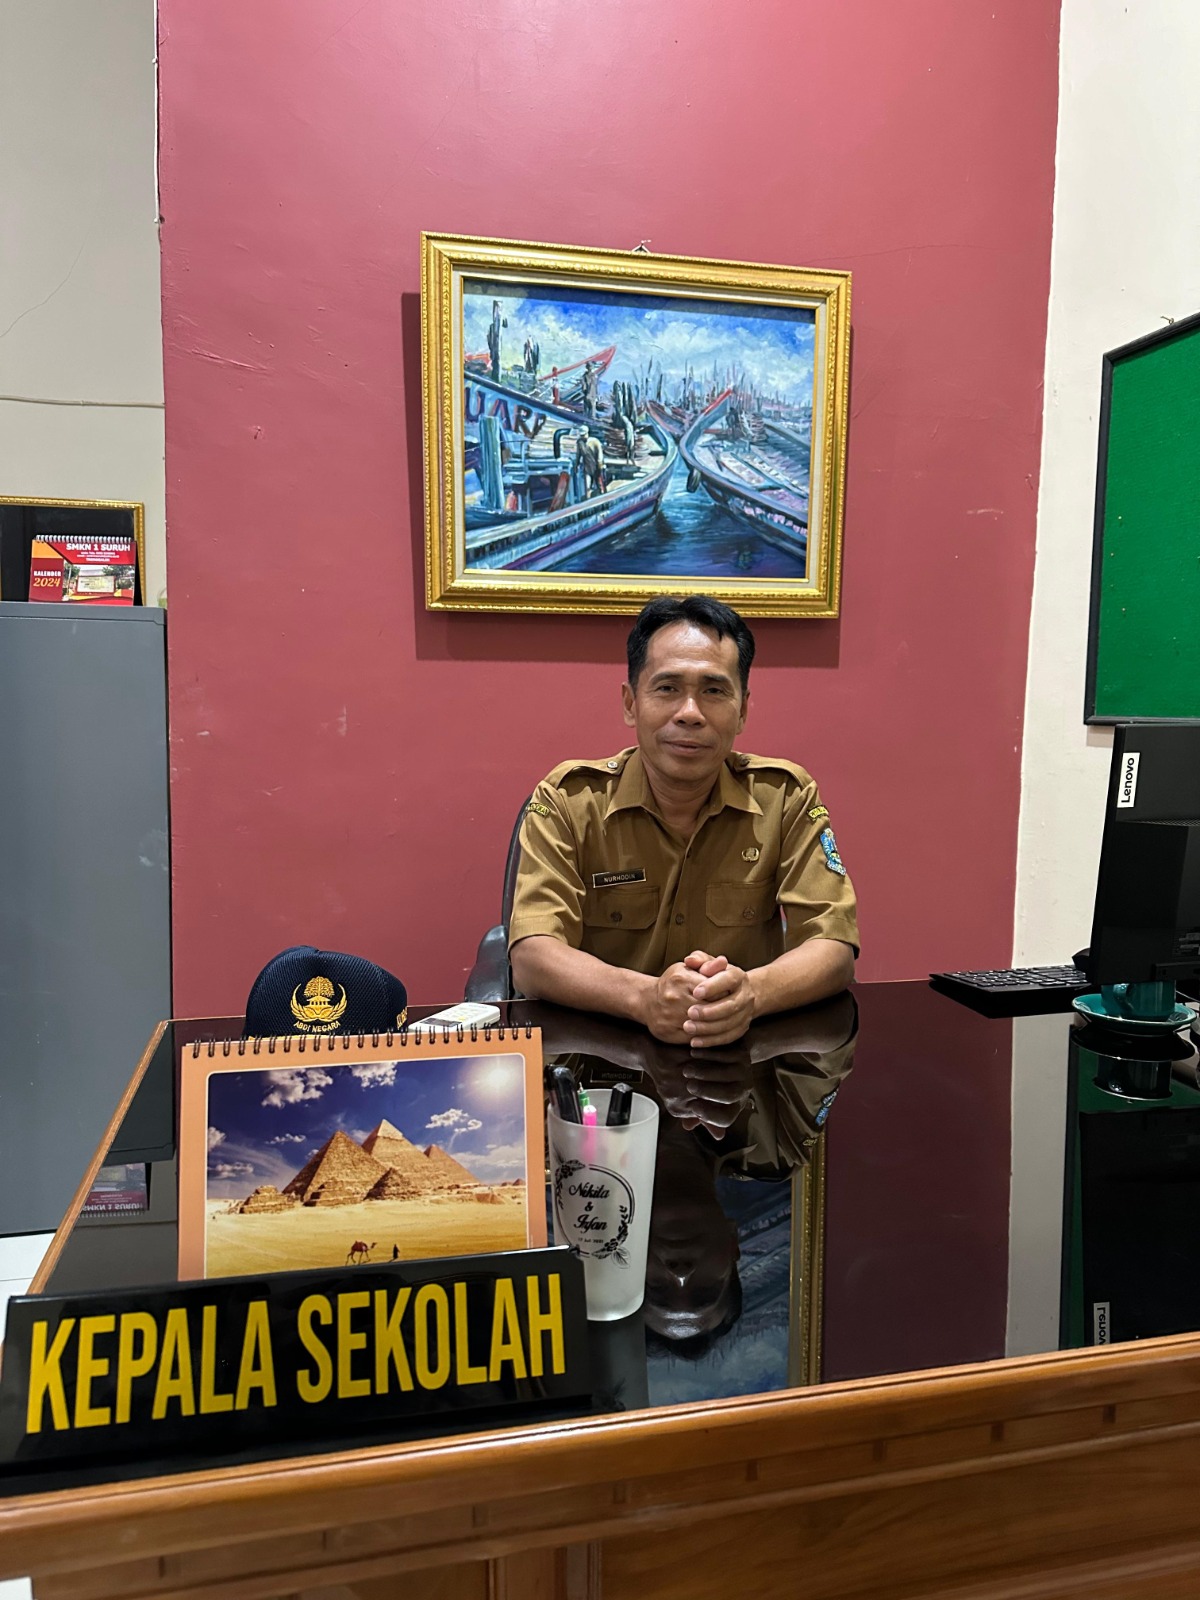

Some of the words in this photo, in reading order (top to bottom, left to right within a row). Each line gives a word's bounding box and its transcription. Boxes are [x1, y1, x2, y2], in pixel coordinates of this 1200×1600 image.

[101, 543, 130, 551] SURUH
[33, 577, 61, 587] 2024
[1121, 757, 1135, 803] Lenovo
[293, 1020, 311, 1032] ABDI
[312, 1020, 341, 1033] NEGARA
[584, 1201, 594, 1212] &
[26, 1301, 277, 1435] KEPALA
[297, 1273, 566, 1403] SEKOLAH
